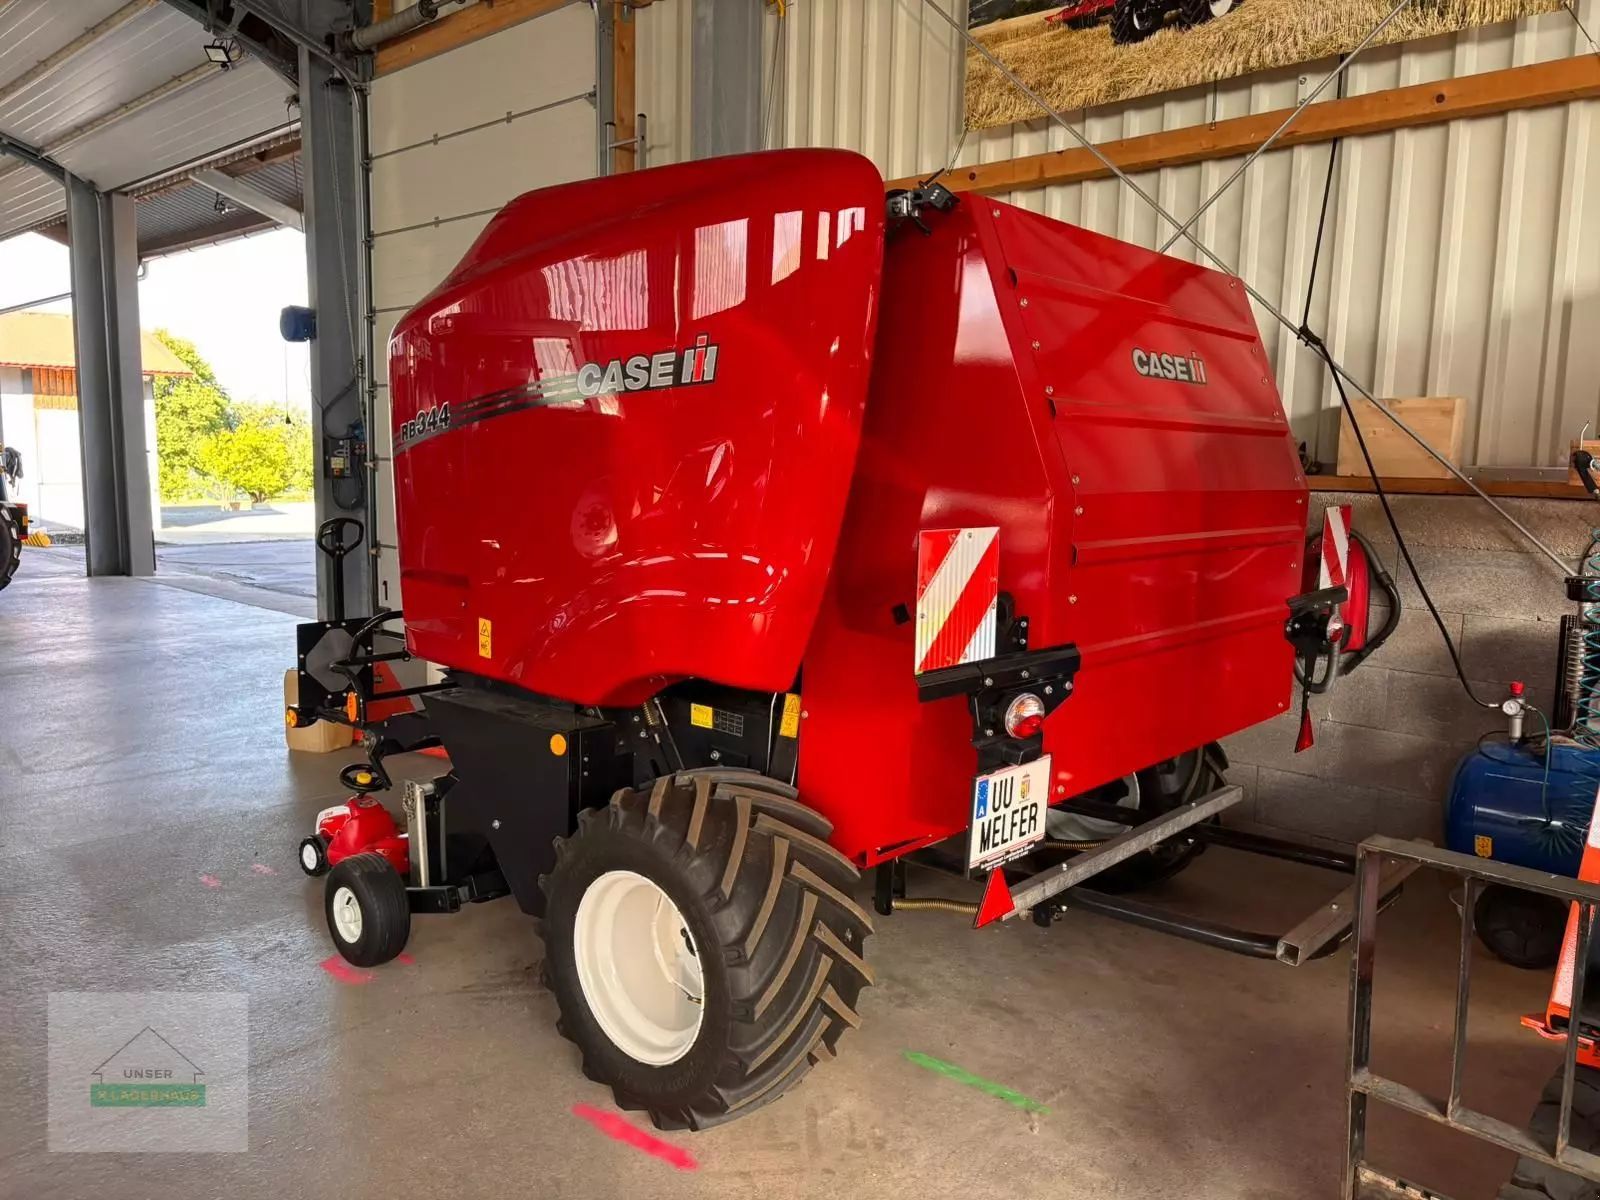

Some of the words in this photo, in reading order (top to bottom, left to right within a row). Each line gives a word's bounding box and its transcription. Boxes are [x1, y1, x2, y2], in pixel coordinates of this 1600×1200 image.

[576, 352, 676, 396] CASE
[1132, 349, 1188, 381] CASE
[382, 580, 388, 601] 1
[992, 776, 1014, 813] UU
[979, 802, 1038, 853] MELFER
